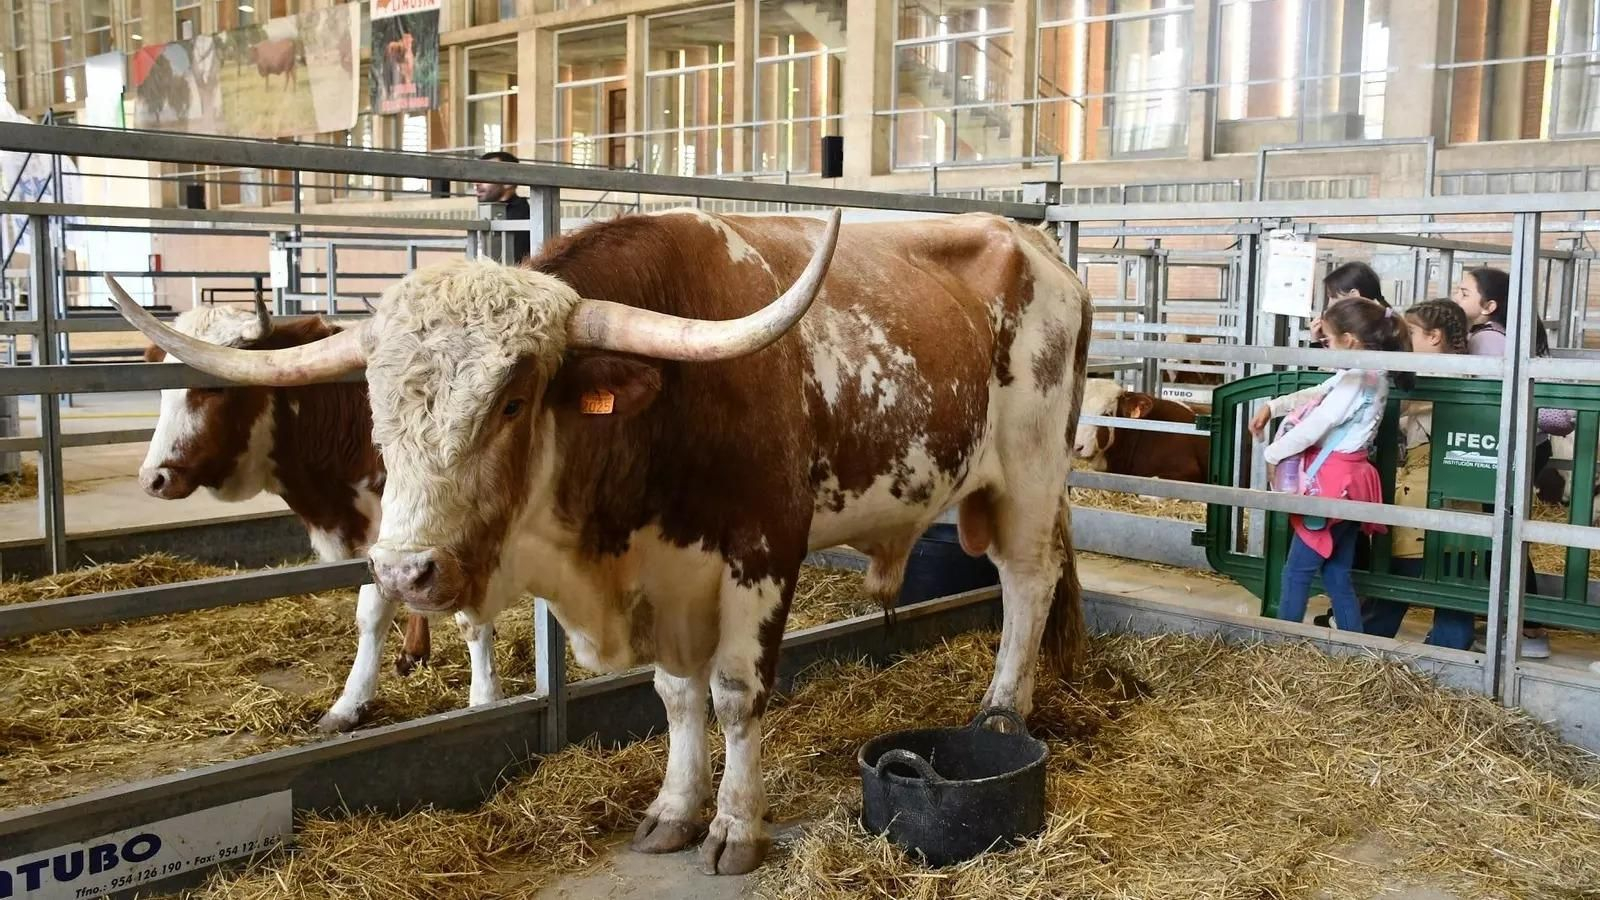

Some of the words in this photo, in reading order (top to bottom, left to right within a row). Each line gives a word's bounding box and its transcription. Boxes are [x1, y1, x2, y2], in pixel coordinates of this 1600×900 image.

[110, 874, 133, 890] 954
[138, 867, 158, 882] 126
[161, 861, 182, 875] 190
[194, 852, 216, 867] Fax:
[219, 845, 238, 859] 954
